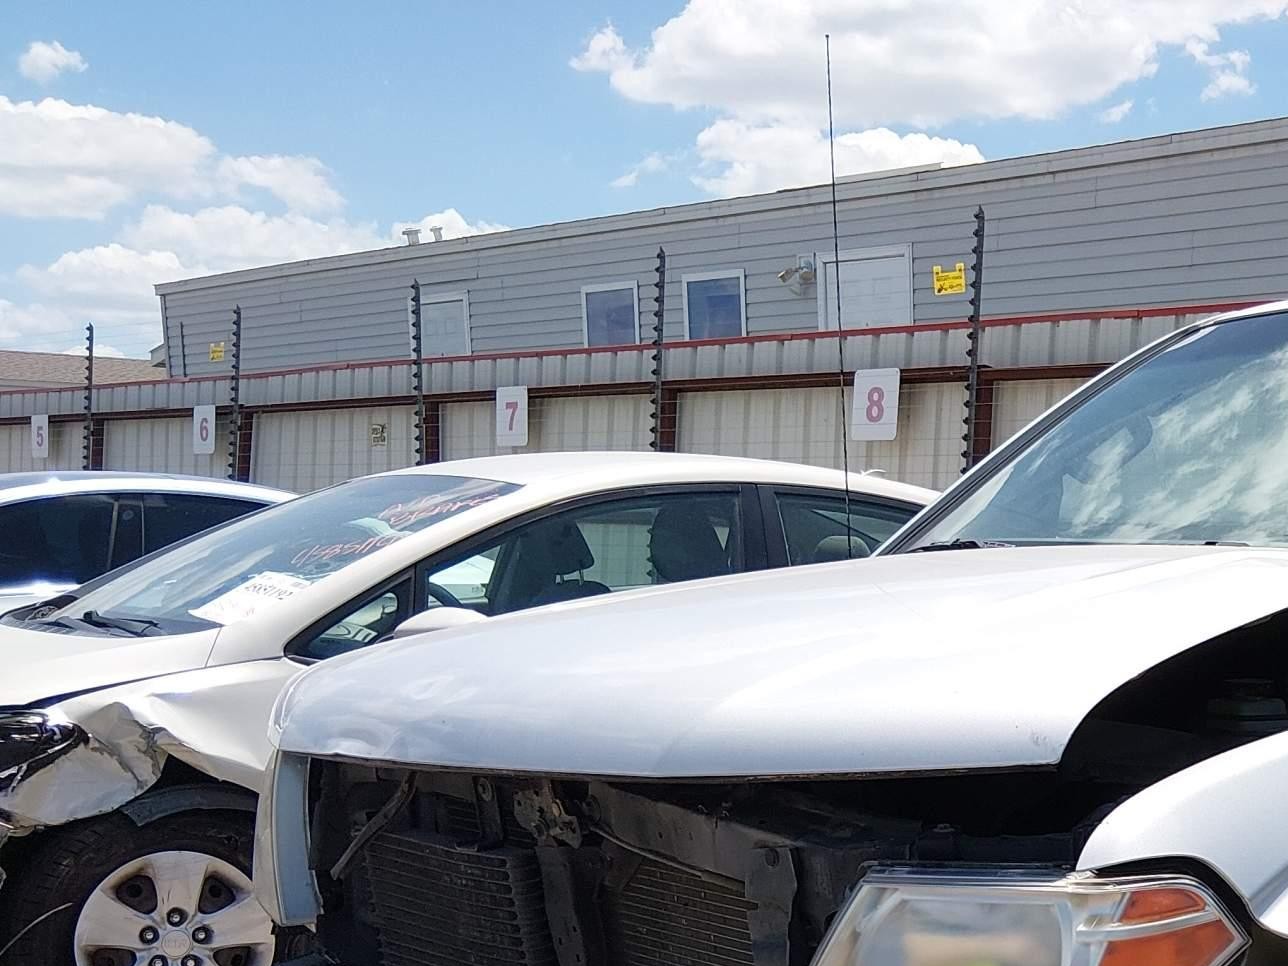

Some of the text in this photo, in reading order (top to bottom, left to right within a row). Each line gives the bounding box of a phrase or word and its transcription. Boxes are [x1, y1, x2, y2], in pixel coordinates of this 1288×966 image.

[504, 401, 520, 432] 7
[866, 386, 885, 423] 8
[35, 425, 45, 447] 5
[199, 416, 210, 442] 6
